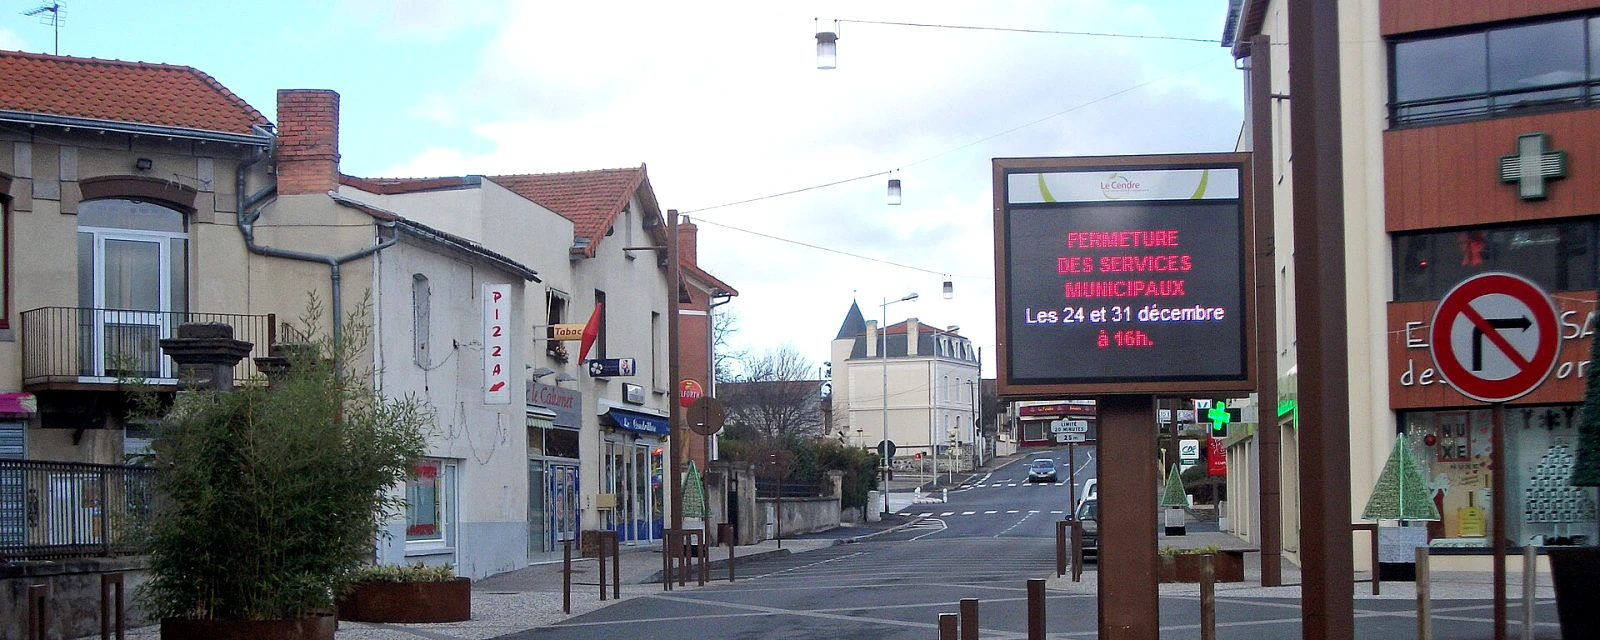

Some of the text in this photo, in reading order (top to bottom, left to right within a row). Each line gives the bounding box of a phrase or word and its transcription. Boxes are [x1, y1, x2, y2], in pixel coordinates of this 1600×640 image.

[1100, 181, 1140, 190] Le Cendre
[1067, 230, 1178, 248] FERMETURE
[1057, 255, 1192, 274] DES SERVICES
[1065, 280, 1186, 298] MUNICIPAUX
[1025, 304, 1225, 324] Les 24 et 31 décembre
[492, 291, 502, 376] PIZZA
[555, 327, 582, 336] Tabac
[1097, 330, 1153, 347] à 16h.
